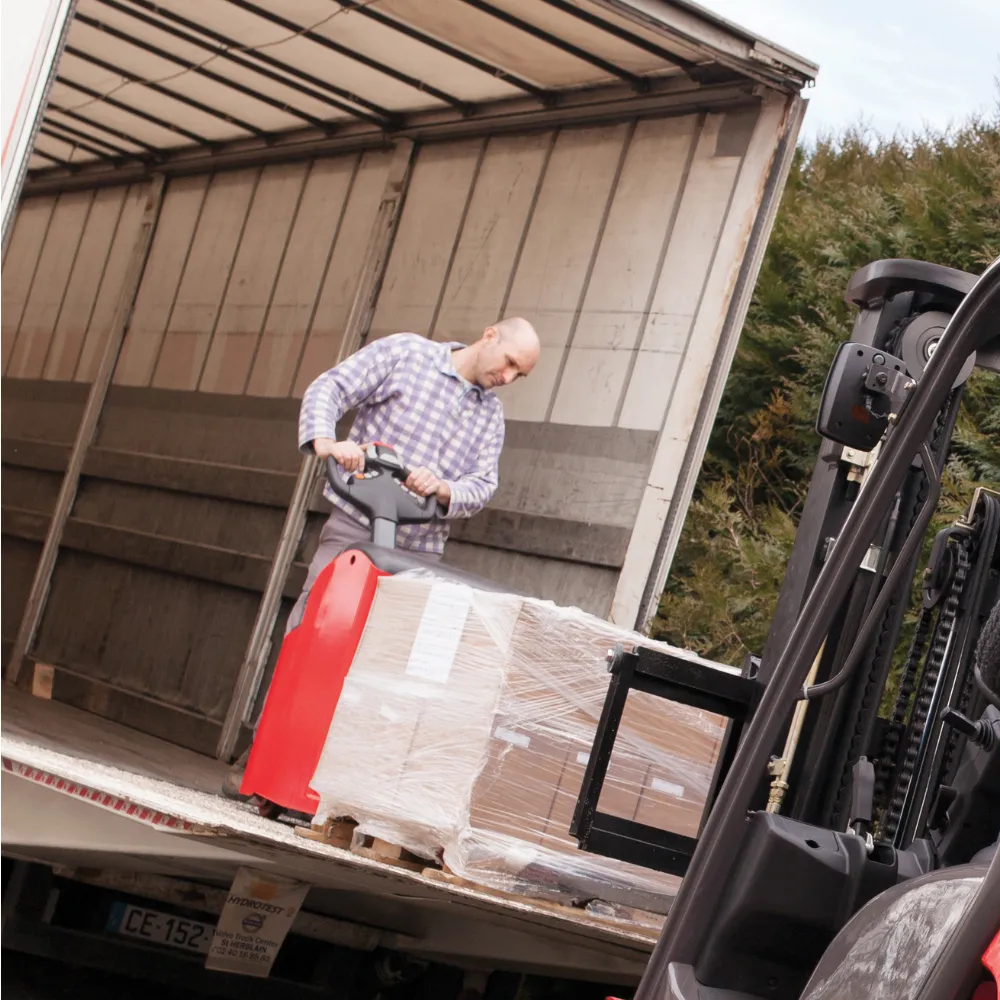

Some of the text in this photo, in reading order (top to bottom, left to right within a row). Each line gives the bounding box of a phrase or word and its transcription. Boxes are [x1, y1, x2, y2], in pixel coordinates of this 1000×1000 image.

[228, 896, 285, 914] HYDROTEST
[230, 941, 268, 953] HERBLAIN
[235, 933, 254, 943] Truck
[255, 937, 279, 947] Center
